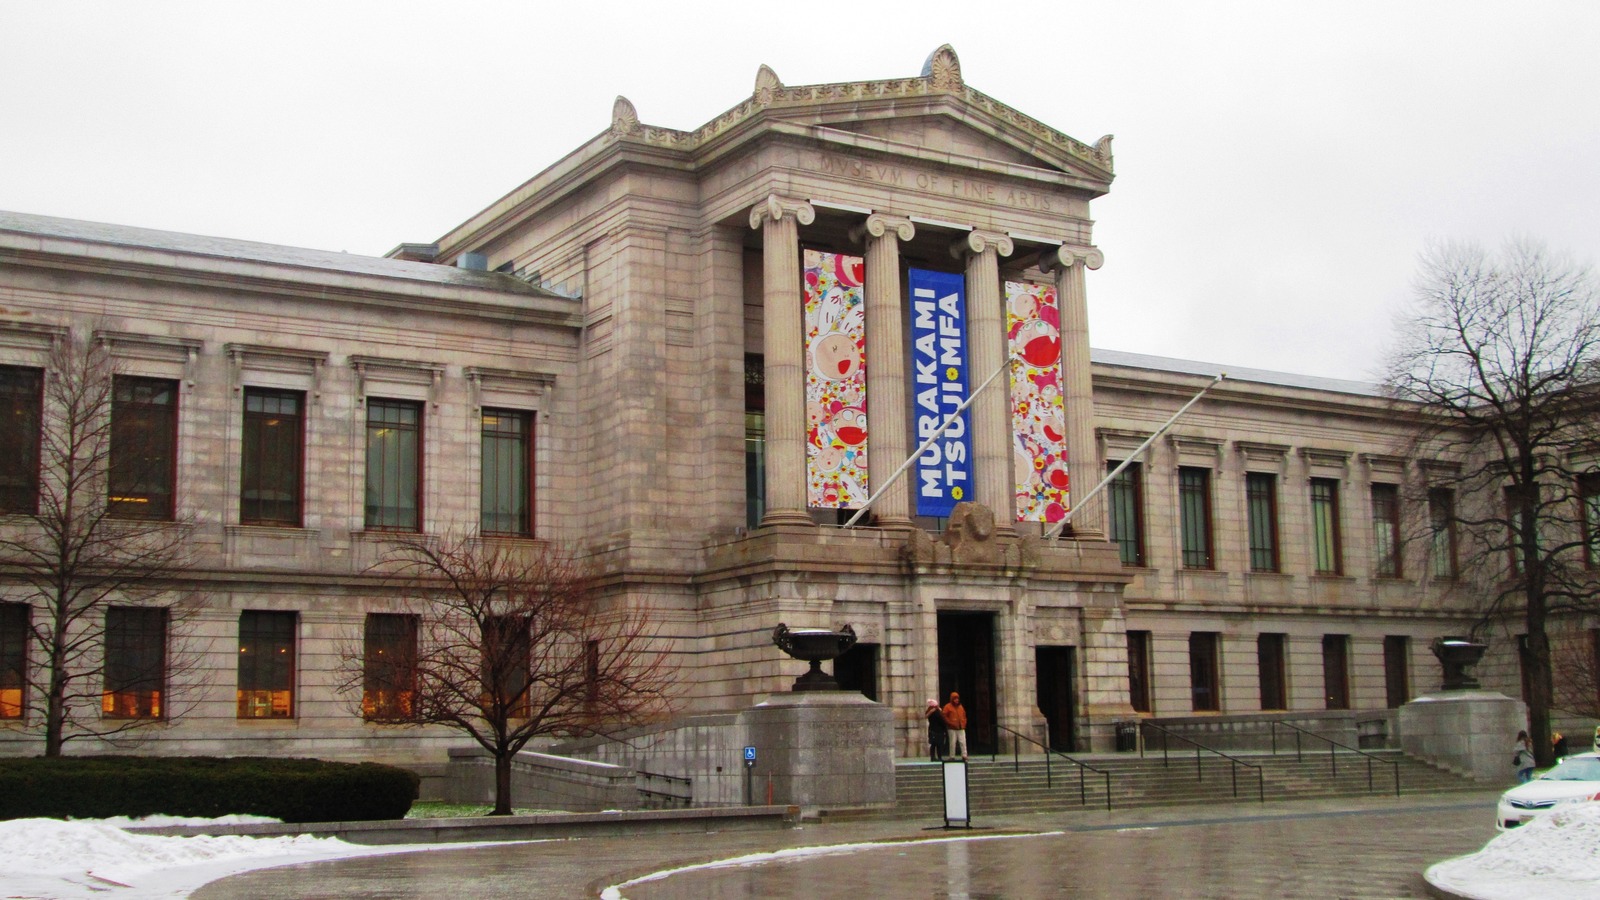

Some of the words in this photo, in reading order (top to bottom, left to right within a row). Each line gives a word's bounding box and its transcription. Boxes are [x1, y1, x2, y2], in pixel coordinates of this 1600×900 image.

[820, 155, 903, 185] MVSEVM
[916, 173, 939, 190] OF
[952, 180, 996, 201] FINE
[1006, 189, 1051, 210] ARTS
[939, 292, 962, 366] MFA
[914, 288, 943, 497] MURAKAMI
[942, 382, 967, 486] TSUJI
